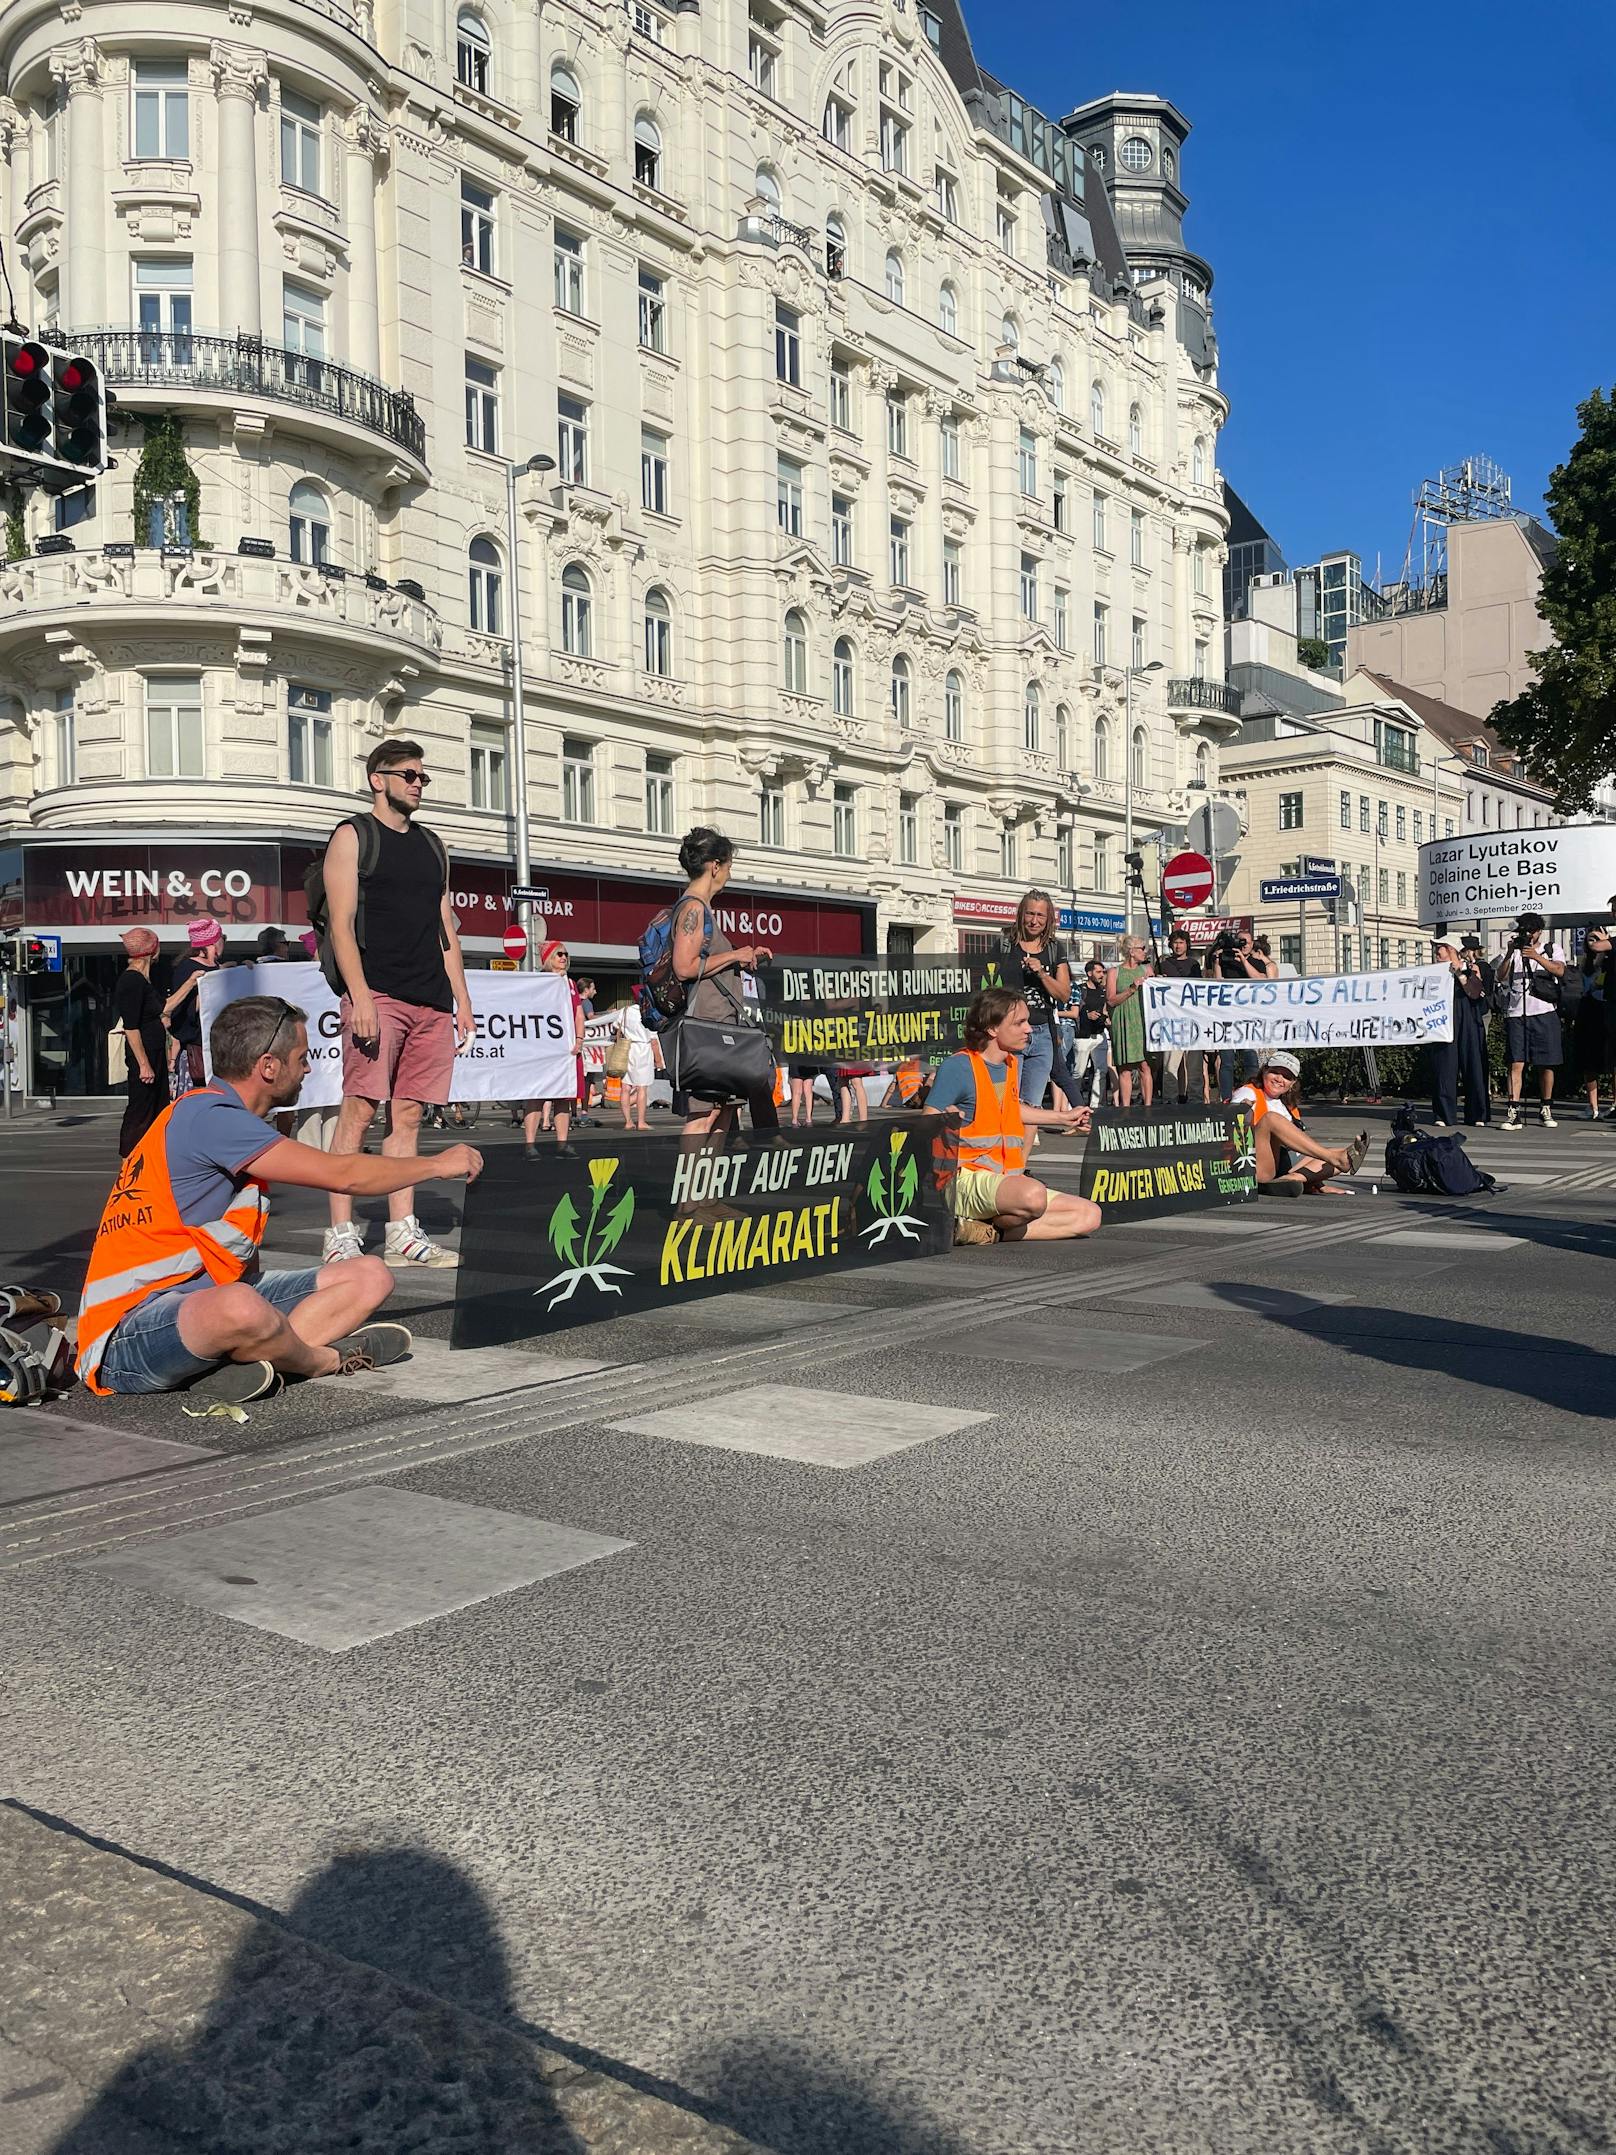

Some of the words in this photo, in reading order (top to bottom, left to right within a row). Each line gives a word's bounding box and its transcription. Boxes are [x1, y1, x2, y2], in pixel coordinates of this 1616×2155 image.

[1429, 848, 1464, 865] Lazar
[1469, 838, 1559, 862] Lyutakov
[65, 869, 159, 898] WEIN
[166, 870, 194, 898] &
[200, 869, 251, 898] CO
[1429, 866, 1481, 886] Delaine
[1487, 862, 1510, 879] Le
[1517, 860, 1558, 876] Bas
[450, 891, 479, 909] OP
[484, 894, 497, 911] &
[502, 896, 574, 917] WNBAR
[1428, 890, 1460, 906] Chen
[1465, 881, 1560, 901] Chieh-jen
[711, 909, 736, 933] IN
[738, 911, 754, 934] &
[756, 912, 783, 936] CO
[981, 904, 1017, 915] ACCESSOR
[1473, 904, 1519, 916] September
[1521, 903, 1543, 911] 2023
[1113, 921, 1126, 930] retail
[1189, 919, 1241, 932] BICYCLE
[783, 968, 810, 1001] DIE
[814, 969, 898, 999] REICHSTEN
[903, 968, 972, 995] RUINIEREN
[1150, 985, 1171, 1009] IT
[1180, 982, 1278, 1007] AFFECTS
[1288, 980, 1323, 1005] US
[1332, 979, 1387, 1003] ALL!
[1399, 975, 1441, 1000] THE
[950, 1006, 971, 1022] LETZ
[1422, 1000, 1447, 1016] MUST
[453, 1014, 564, 1039] ECHTS
[784, 1016, 860, 1053] UNSERE
[864, 1010, 944, 1046] ZUKUNFT.
[1150, 1017, 1199, 1046] GREED
[1426, 1014, 1449, 1030] STOP
[1098, 1125, 1119, 1151] WIR
[1118, 1126, 1147, 1149] RASEN
[1148, 1126, 1157, 1147] IN
[1159, 1125, 1174, 1146] DIE
[1175, 1118, 1229, 1145] KLIMAHÖLLE.
[670, 1147, 747, 1205] HÖRT
[749, 1148, 803, 1194] AUF
[806, 1142, 855, 1186] DEN
[1091, 1169, 1154, 1202] RUNTER
[1154, 1166, 1180, 1196] VOM
[1177, 1159, 1206, 1192] GAS!
[1210, 1160, 1232, 1176] LETZTE
[100, 1205, 153, 1237] ATION.AT
[660, 1195, 841, 1286] KLIMARAT!
